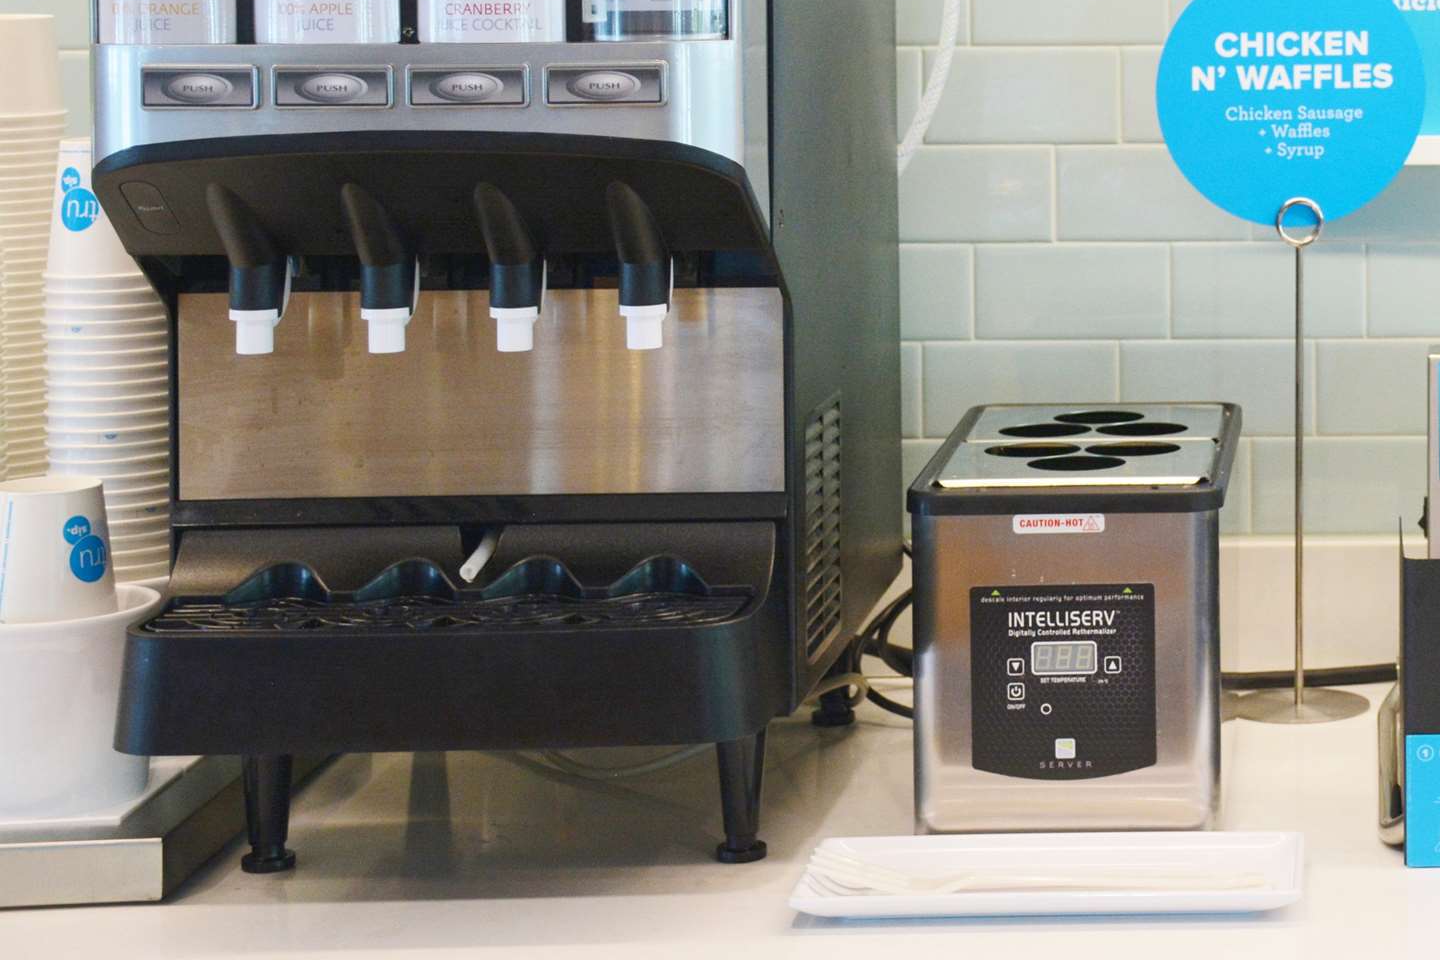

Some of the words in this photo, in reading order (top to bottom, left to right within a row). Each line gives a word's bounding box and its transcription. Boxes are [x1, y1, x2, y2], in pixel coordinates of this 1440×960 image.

[309, 2, 353, 16] APPLE
[297, 18, 335, 32] JUICE
[1215, 30, 1369, 58] CHICKEN
[1236, 63, 1394, 91] WAFFLES
[183, 84, 213, 92] PUSH
[316, 84, 347, 92] PUSH
[452, 83, 483, 91] PUSH
[588, 82, 620, 90] PUSH
[1225, 105, 1292, 122] Chicken
[1297, 105, 1363, 122] Sausage
[1271, 123, 1330, 138] Waffles
[1277, 142, 1324, 159] Syrup
[1019, 518, 1084, 528] CAUTION-HOT
[1075, 595, 1102, 603] optimum
[1104, 594, 1144, 602] performance
[1008, 629, 1036, 637] Digitally
[1037, 628, 1070, 636] Controlled
[1072, 628, 1117, 636] Rethermalizer
[1040, 760, 1093, 769] SERVER
